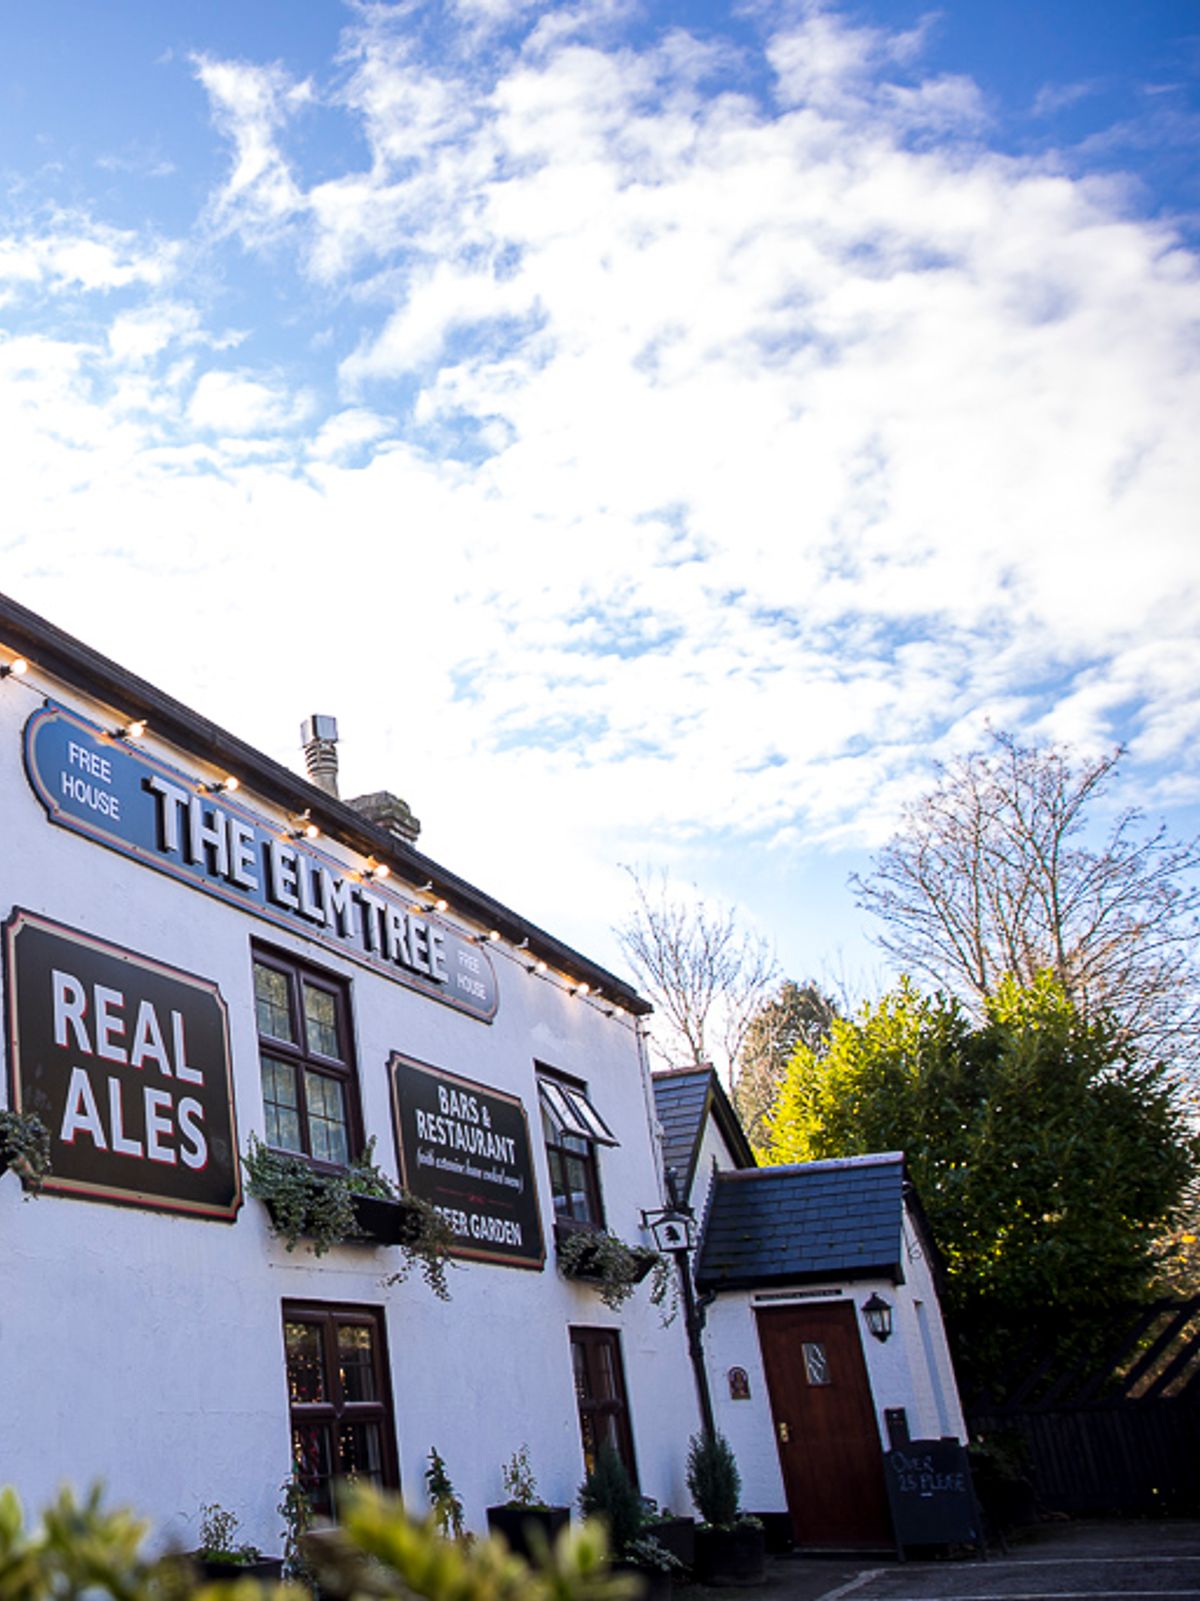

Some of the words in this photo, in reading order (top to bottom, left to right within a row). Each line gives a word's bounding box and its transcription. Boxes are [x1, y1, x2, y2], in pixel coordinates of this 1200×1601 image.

[68, 741, 112, 785] FREE
[61, 771, 121, 822] HOUSE
[146, 775, 259, 891] THE
[268, 839, 356, 940] ELM
[357, 887, 449, 985] TREE
[457, 948, 481, 975] FREE
[456, 971, 487, 1001] HOUSE
[52, 968, 204, 1086] REAL
[59, 1065, 209, 1171] ALES
[437, 1085, 479, 1124] BARS
[482, 1105, 492, 1128] &
[416, 1108, 516, 1165] RESTAURANT
[469, 1213, 522, 1246] GARDEN
